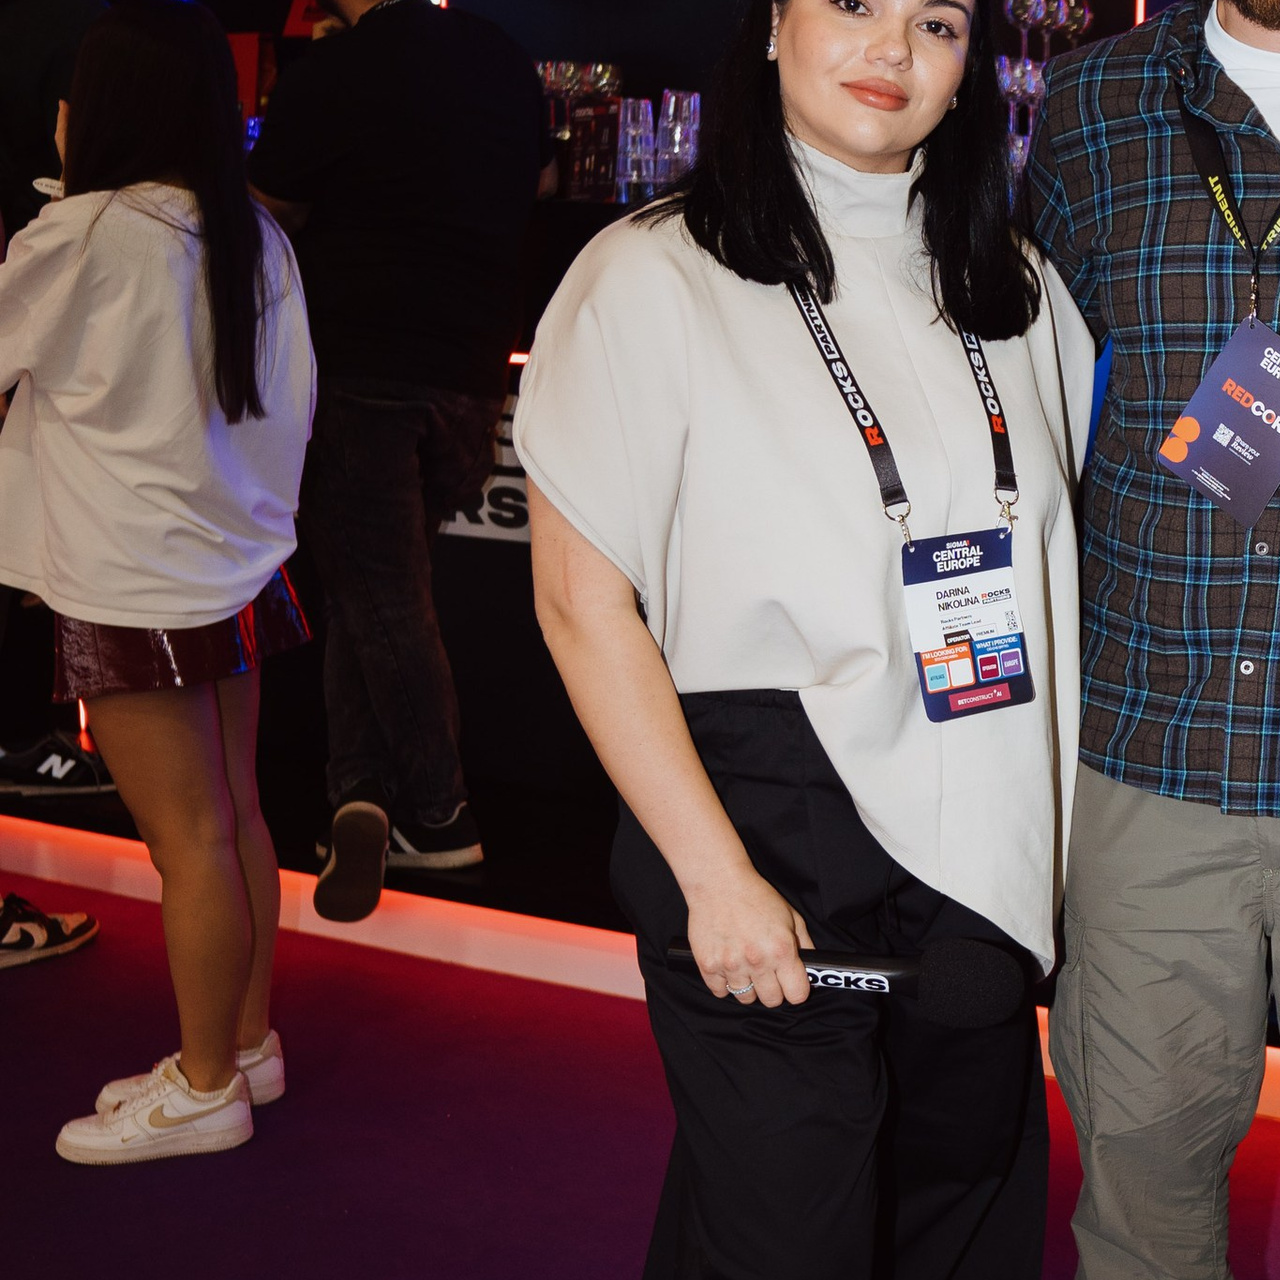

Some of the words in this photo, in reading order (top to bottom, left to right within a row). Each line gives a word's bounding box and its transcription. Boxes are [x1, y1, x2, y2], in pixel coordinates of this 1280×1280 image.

[1208, 175, 1247, 250] TRIDENT
[799, 292, 836, 356] PARTN
[970, 351, 1005, 434] ROCKS
[832, 361, 884, 446] ROCKS
[932, 545, 983, 562] CENTRAL
[937, 556, 981, 573] EUROPE
[936, 586, 970, 600] DARINA
[981, 588, 1011, 599] ROCKS
[938, 596, 980, 612] NIKOLINA
[37, 753, 76, 780] N
[807, 972, 886, 991] OCKS
